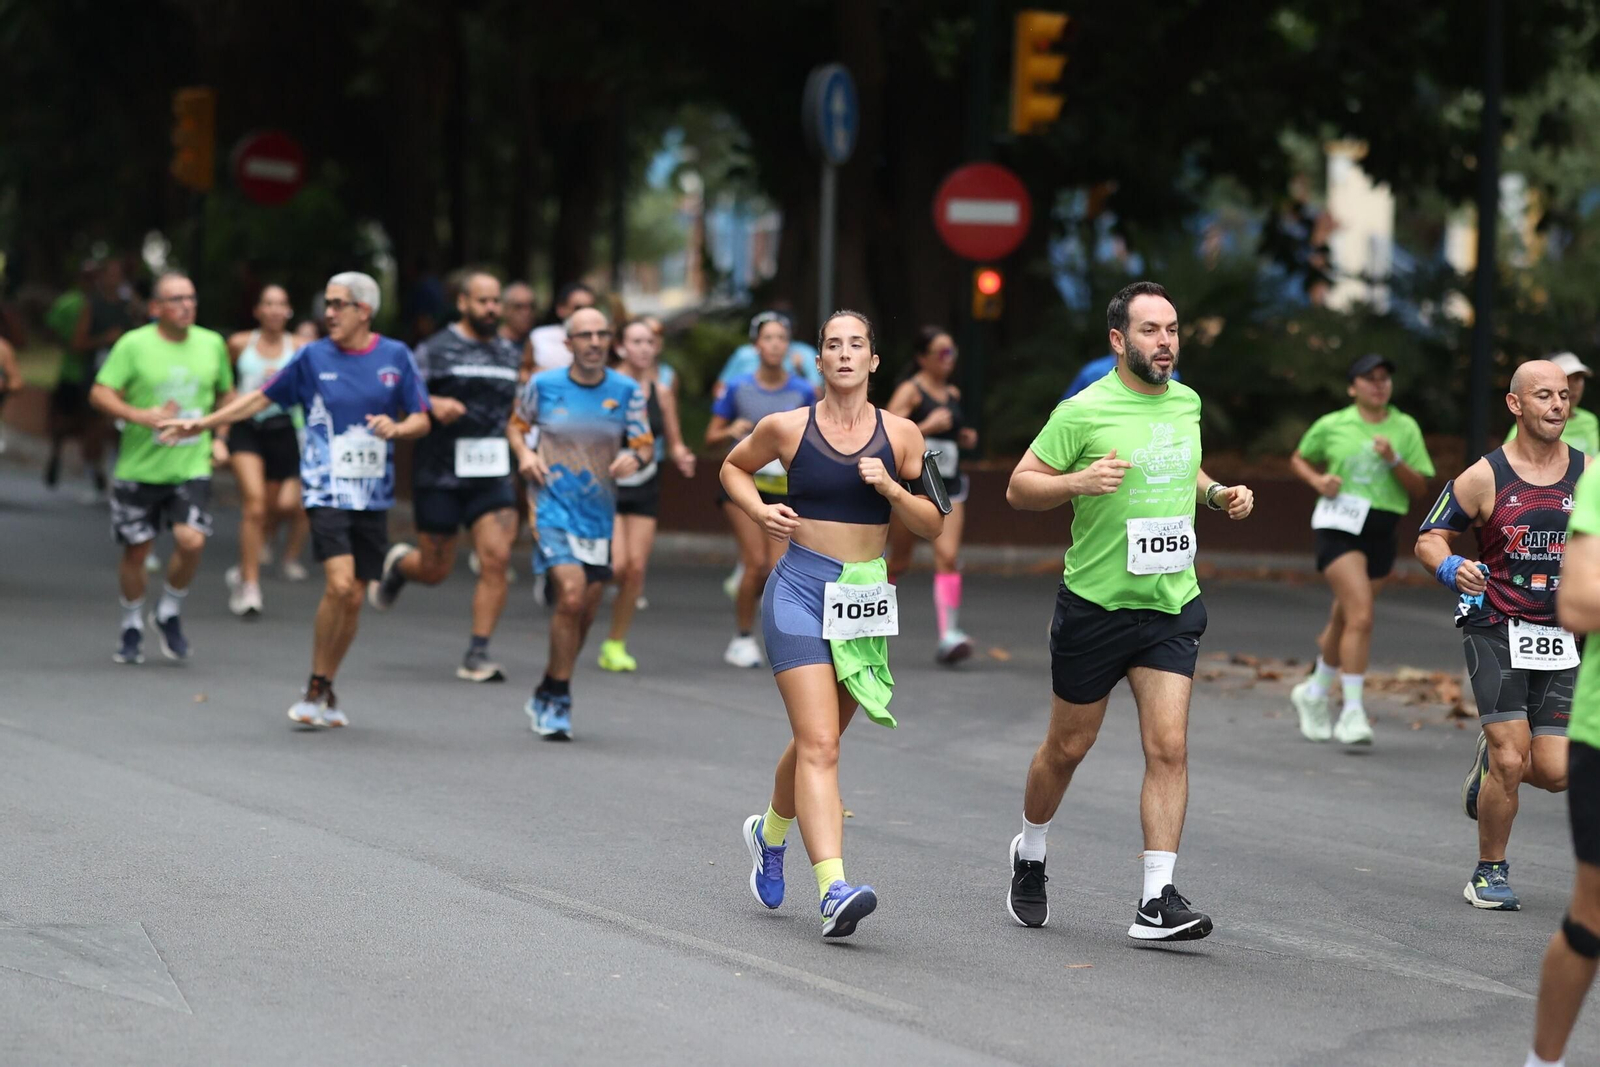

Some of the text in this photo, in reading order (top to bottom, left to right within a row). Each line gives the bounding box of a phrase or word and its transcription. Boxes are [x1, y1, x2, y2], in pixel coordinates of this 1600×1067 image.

[341, 452, 378, 464] 419
[1136, 535, 1190, 554] 1058
[1522, 531, 1567, 548] CARRE
[832, 600, 888, 619] 1056
[1519, 636, 1565, 656] 286
